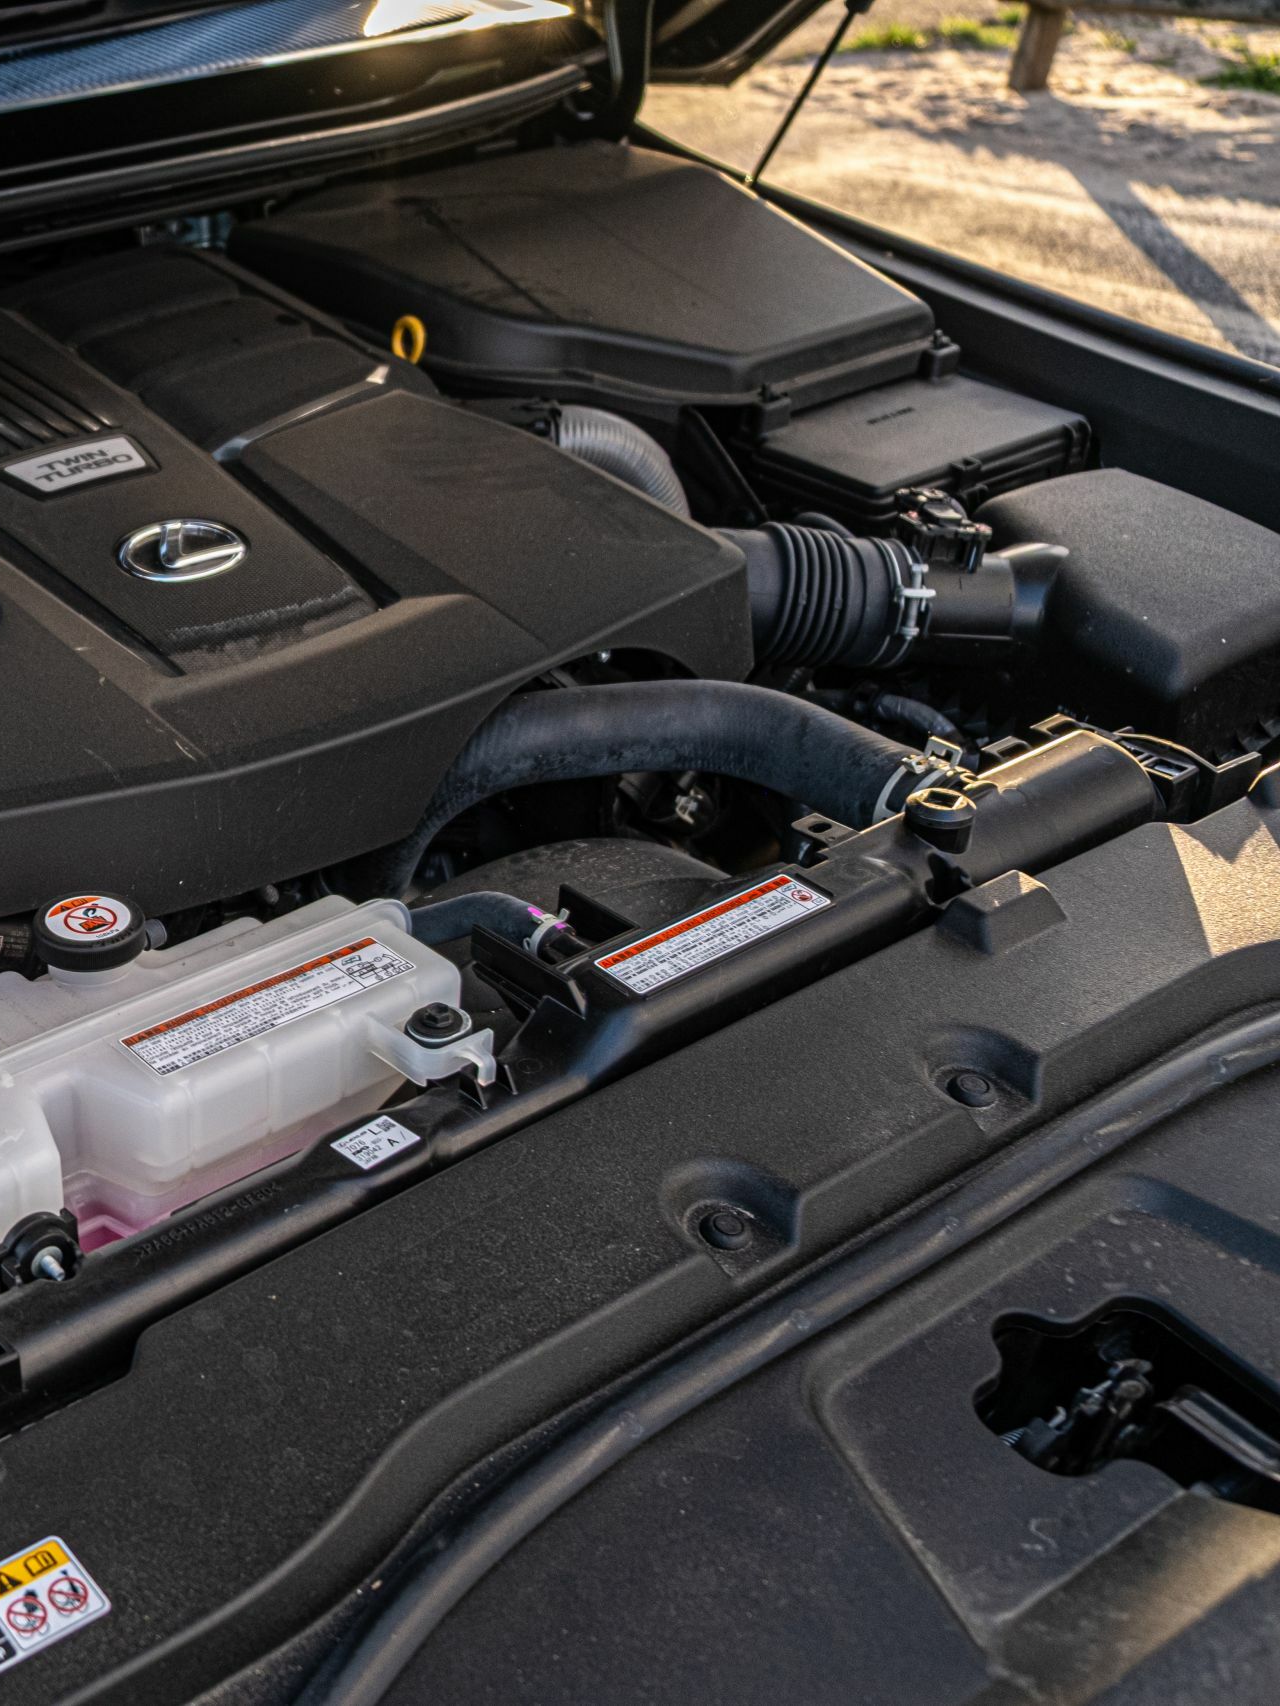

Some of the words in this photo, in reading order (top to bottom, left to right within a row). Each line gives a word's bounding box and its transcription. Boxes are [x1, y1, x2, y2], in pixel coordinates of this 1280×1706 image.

[34, 453, 133, 483] TURBO
[36, 449, 108, 471] TWIN
[386, 1137, 400, 1147] A
